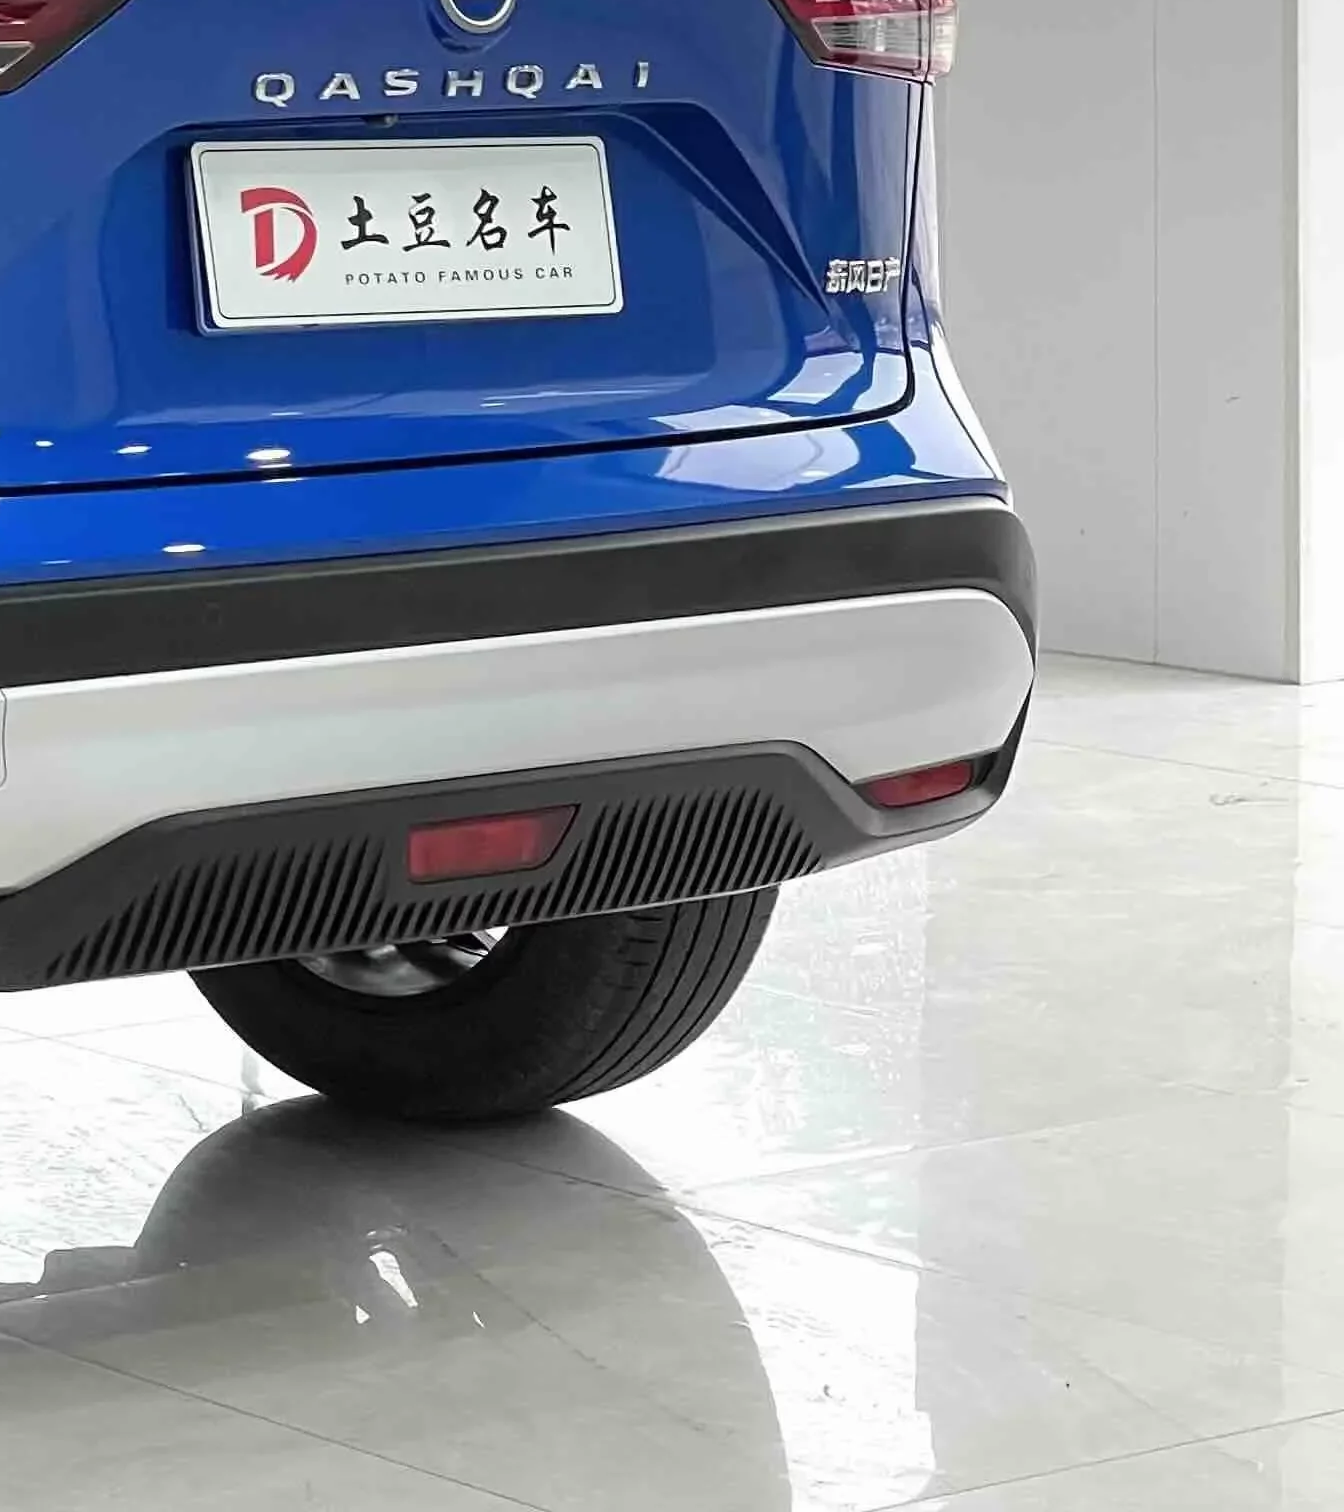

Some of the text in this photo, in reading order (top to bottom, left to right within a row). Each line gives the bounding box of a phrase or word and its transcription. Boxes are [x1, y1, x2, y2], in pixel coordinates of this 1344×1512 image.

[254, 61, 650, 108] QASHQAI
[340, 185, 571, 255] 土豆名车
[345, 265, 575, 286] POTATO FAMOUS CAR
